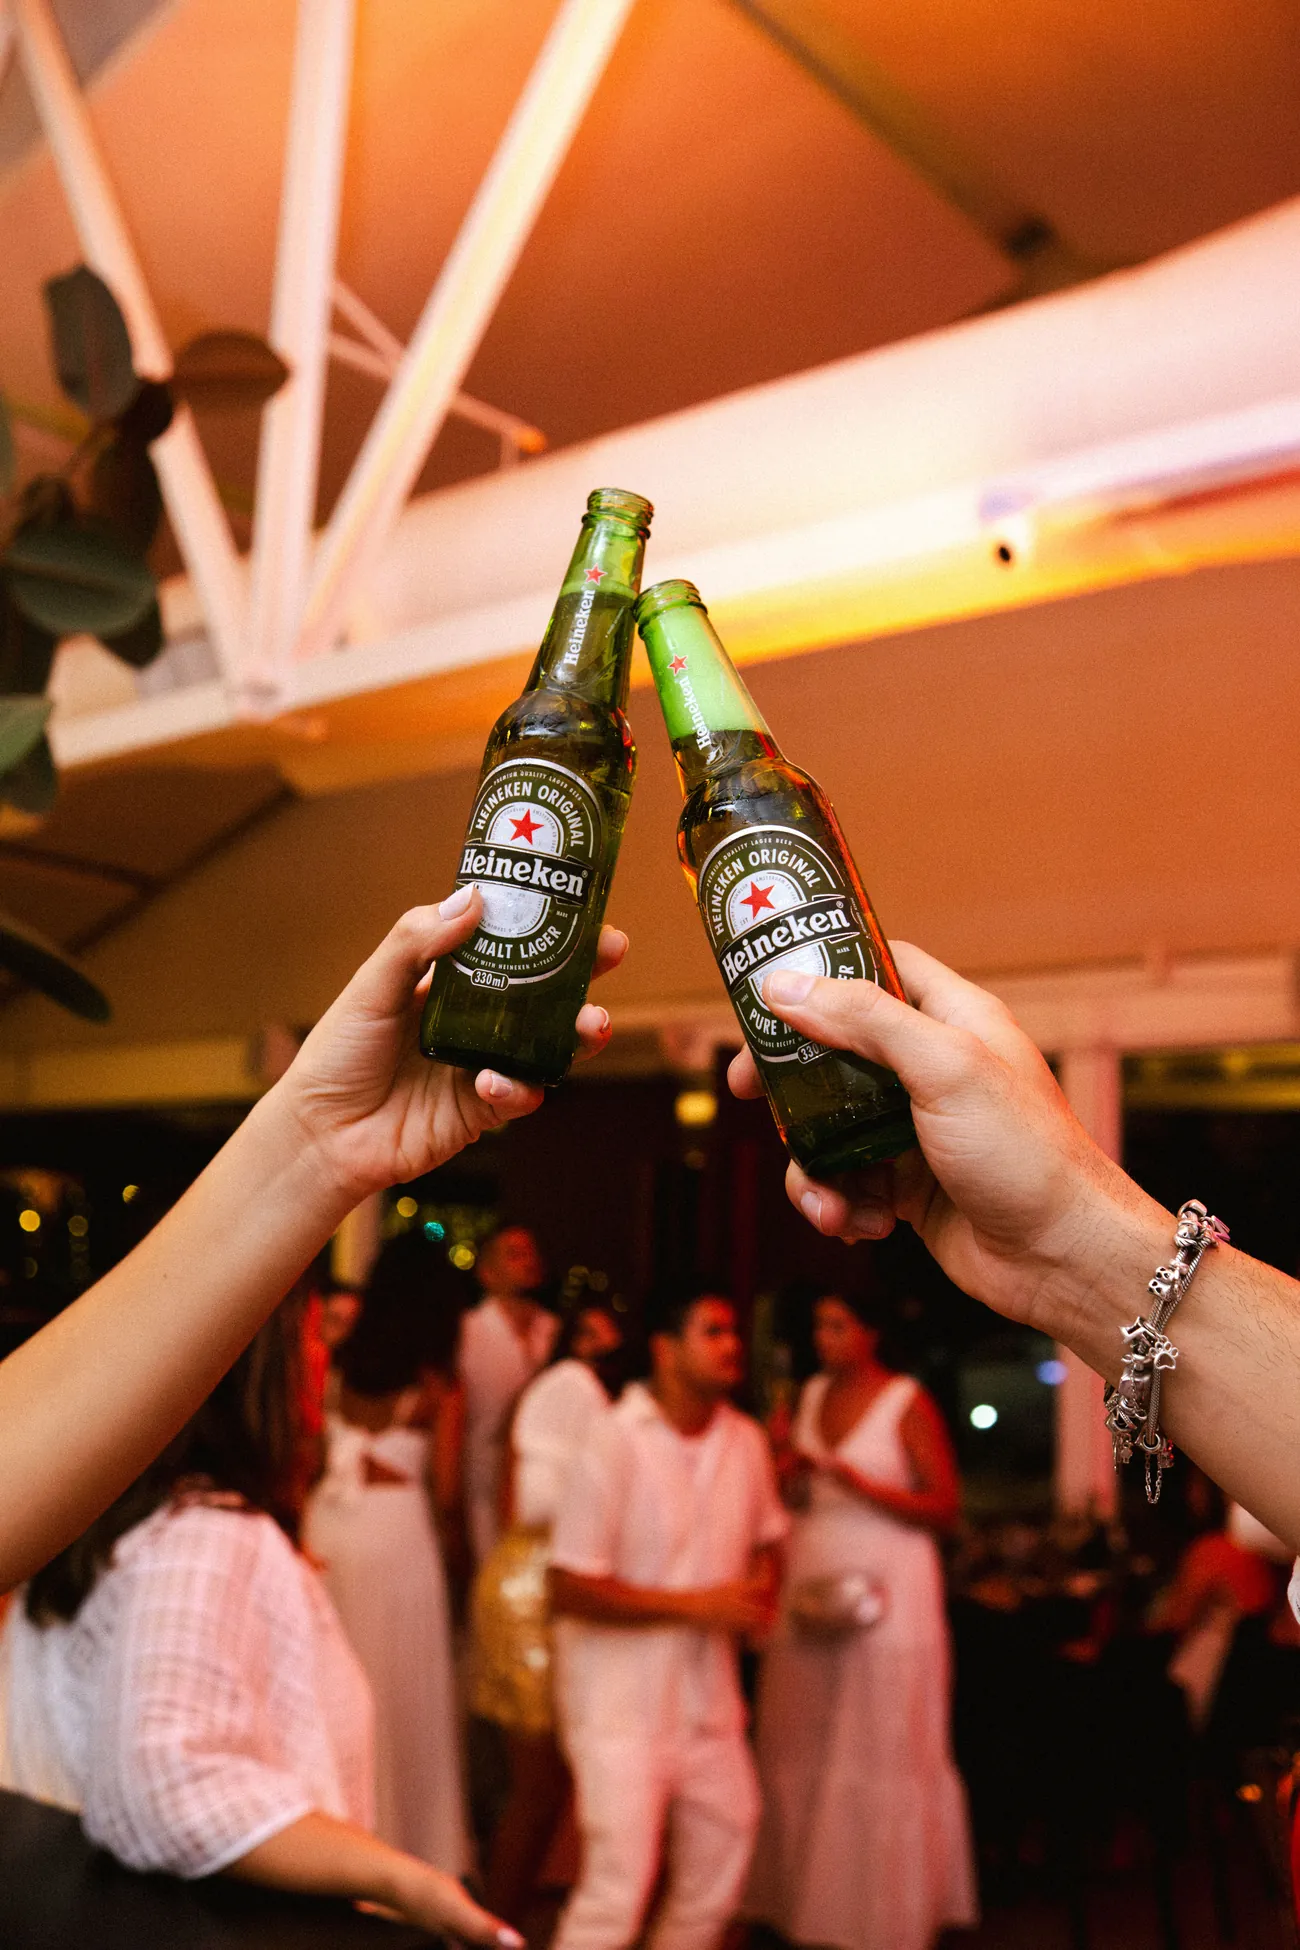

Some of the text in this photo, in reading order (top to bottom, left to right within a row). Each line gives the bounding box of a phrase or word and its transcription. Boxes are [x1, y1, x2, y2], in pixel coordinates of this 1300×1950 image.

[563, 589, 596, 666] Heineken
[679, 675, 712, 750] Heineken
[520, 770, 546, 780] QUALITY
[548, 775, 568, 789] LAGER
[475, 781, 584, 847] HEINEKEN ORIGINAL
[460, 848, 583, 897] Heineken
[706, 838, 792, 887] PREMIUM QUALITY LAGER BEER
[711, 857, 745, 936] HEINEKEN
[748, 848, 821, 888] ORIGINAL
[474, 925, 562, 959] MALT LAGER
[480, 959, 496, 968] WITH
[498, 963, 530, 971] HEINEKEN
[533, 953, 556, 968] A-YEAST
[721, 908, 850, 985] Heineken
[474, 971, 505, 988] 330ml
[749, 1008, 777, 1036] PURE
[776, 1039, 795, 1048] RECIPE
